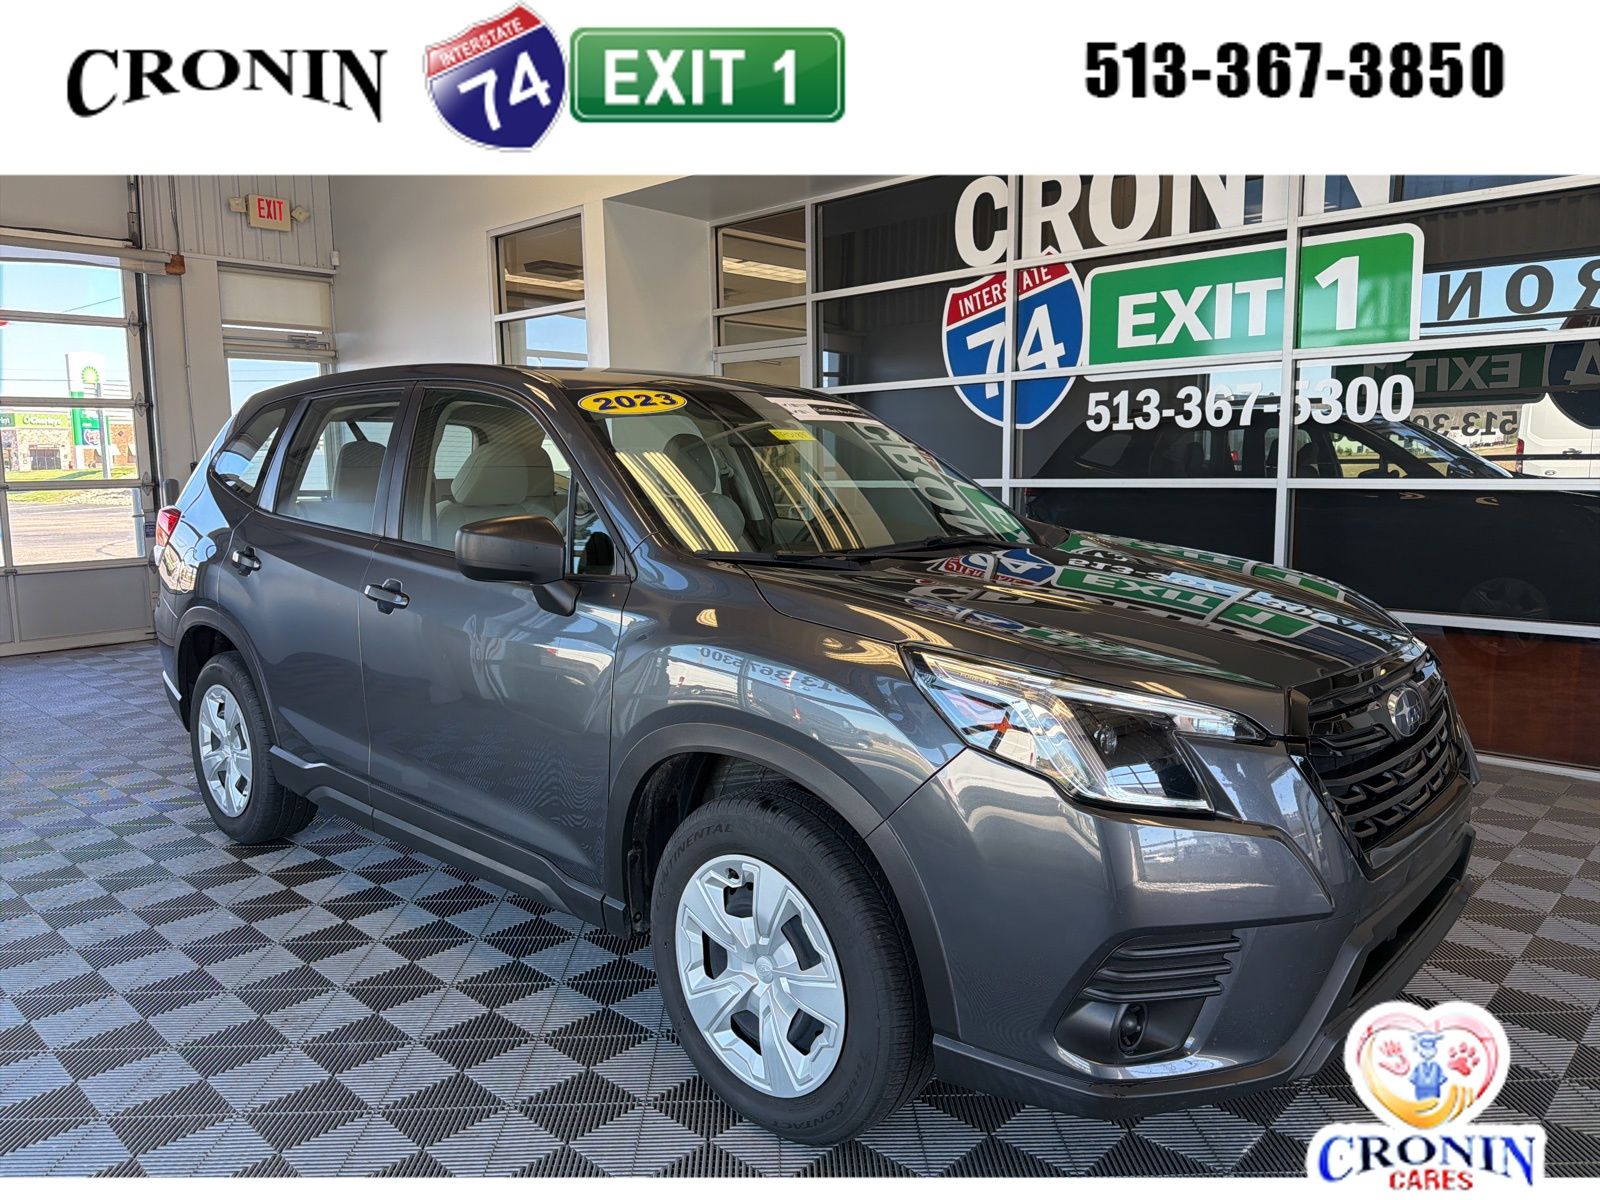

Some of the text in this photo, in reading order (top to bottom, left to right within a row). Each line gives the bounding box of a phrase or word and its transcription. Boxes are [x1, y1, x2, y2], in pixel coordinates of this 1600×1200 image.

[257, 197, 284, 221] EXIT
[958, 266, 1052, 318] INTERSATE
[1117, 255, 1360, 349] EXIT 1
[966, 303, 1066, 399] 74
[592, 393, 678, 411] 2023
[1085, 374, 1415, 432] 513-367-5300
